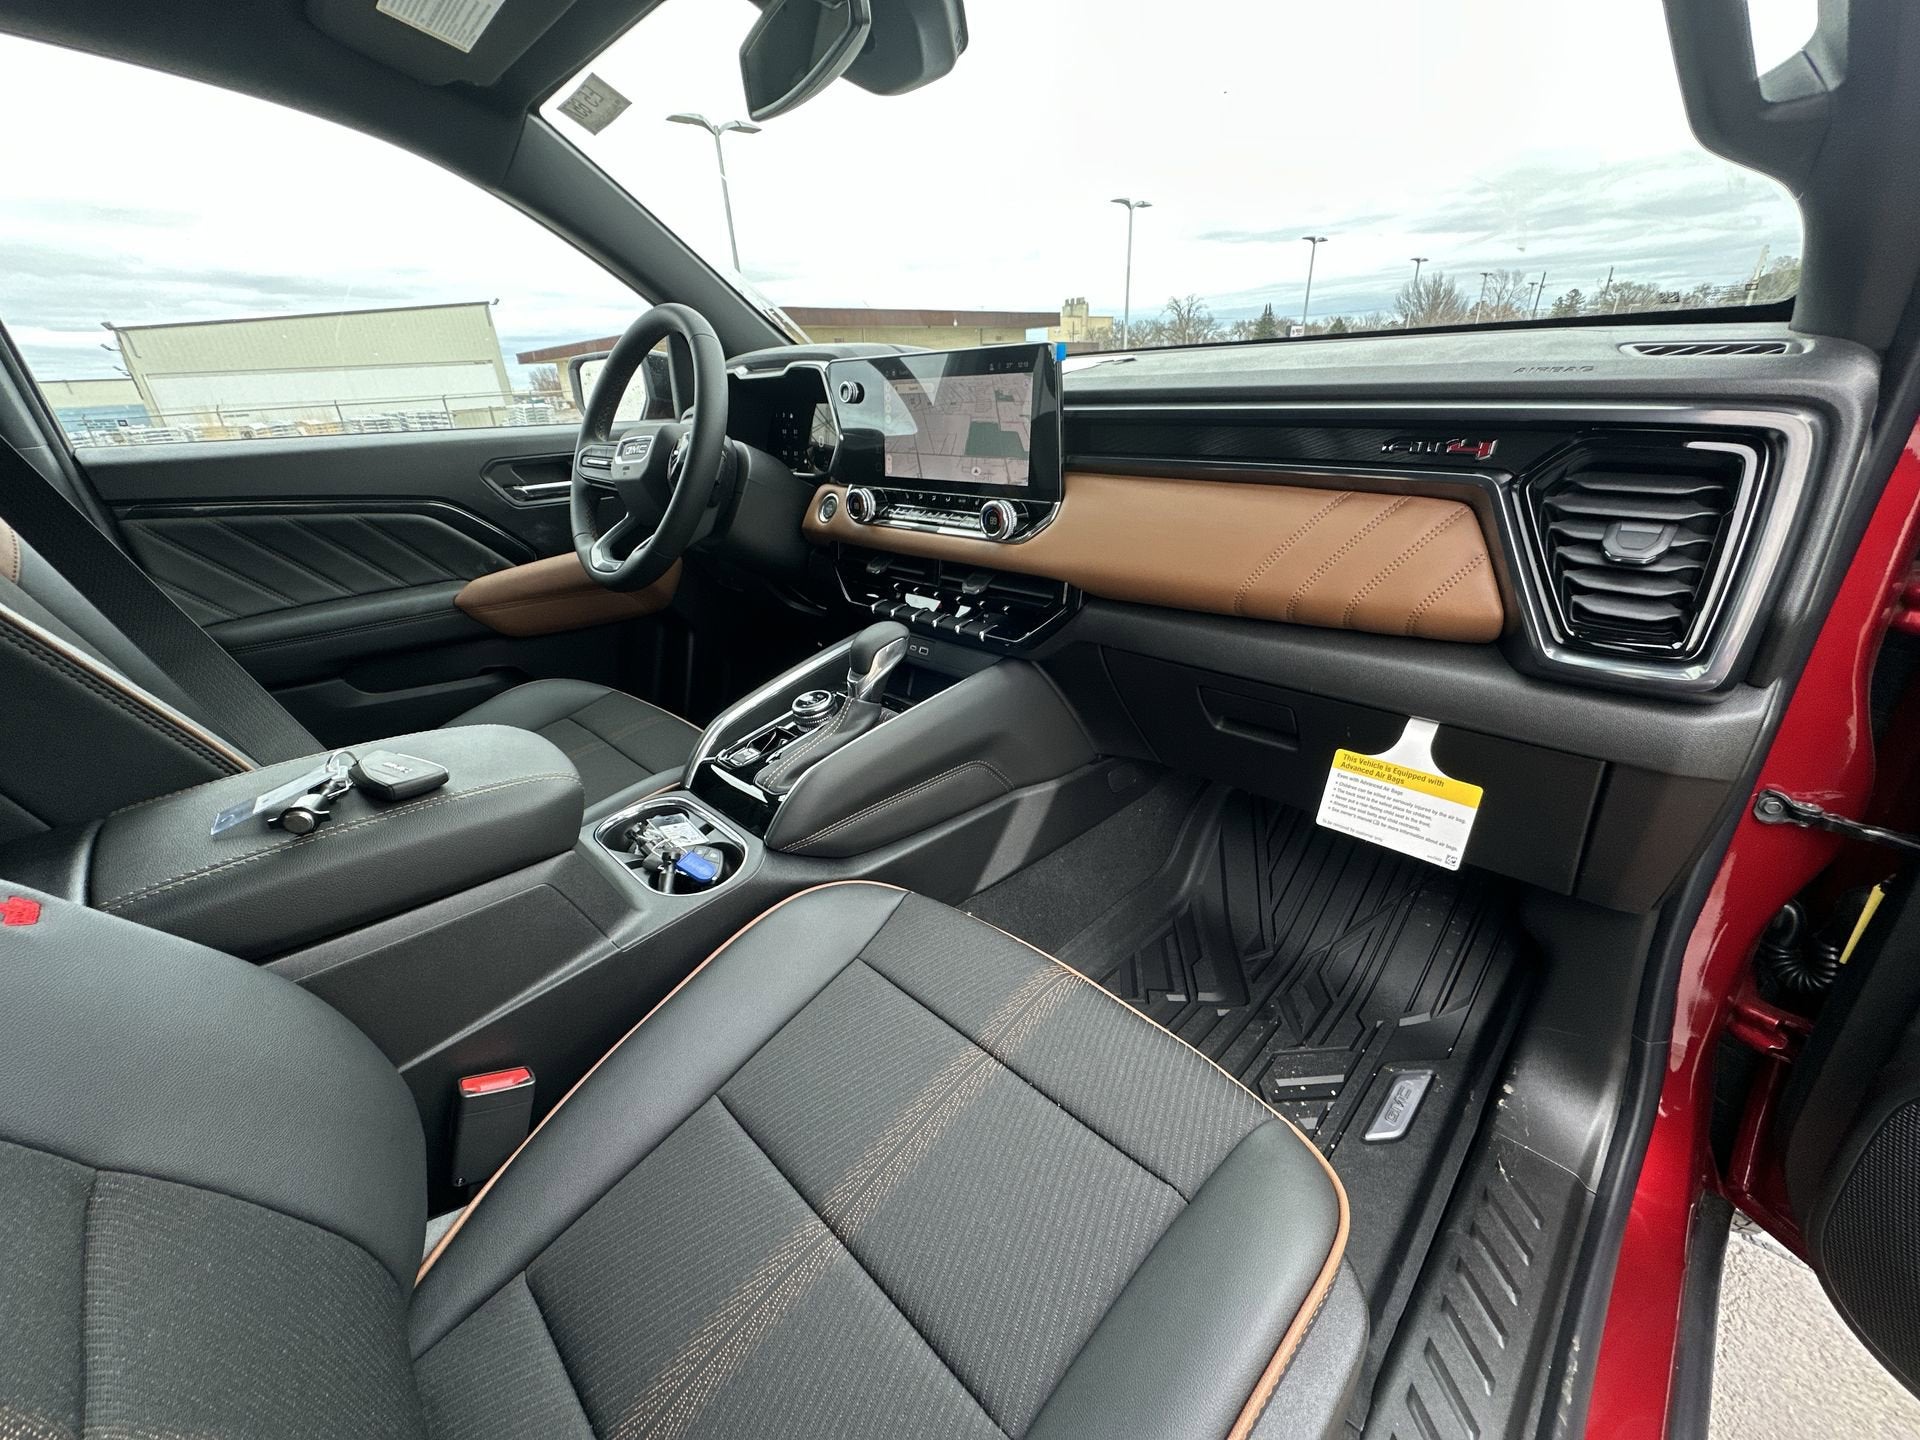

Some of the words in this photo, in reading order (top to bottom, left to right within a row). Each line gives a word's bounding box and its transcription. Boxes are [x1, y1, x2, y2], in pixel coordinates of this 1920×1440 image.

[624, 444, 648, 455] GMC
[1340, 761, 1374, 776] Advanced
[1374, 770, 1385, 779] Air
[1386, 773, 1405, 785] Bags
[1342, 753, 1357, 763] This
[1359, 757, 1384, 770] Vehicle
[1384, 764, 1391, 772] is
[1392, 766, 1426, 782] Equipped
[1427, 776, 1445, 787] with
[1385, 1085, 1413, 1123] GMC
